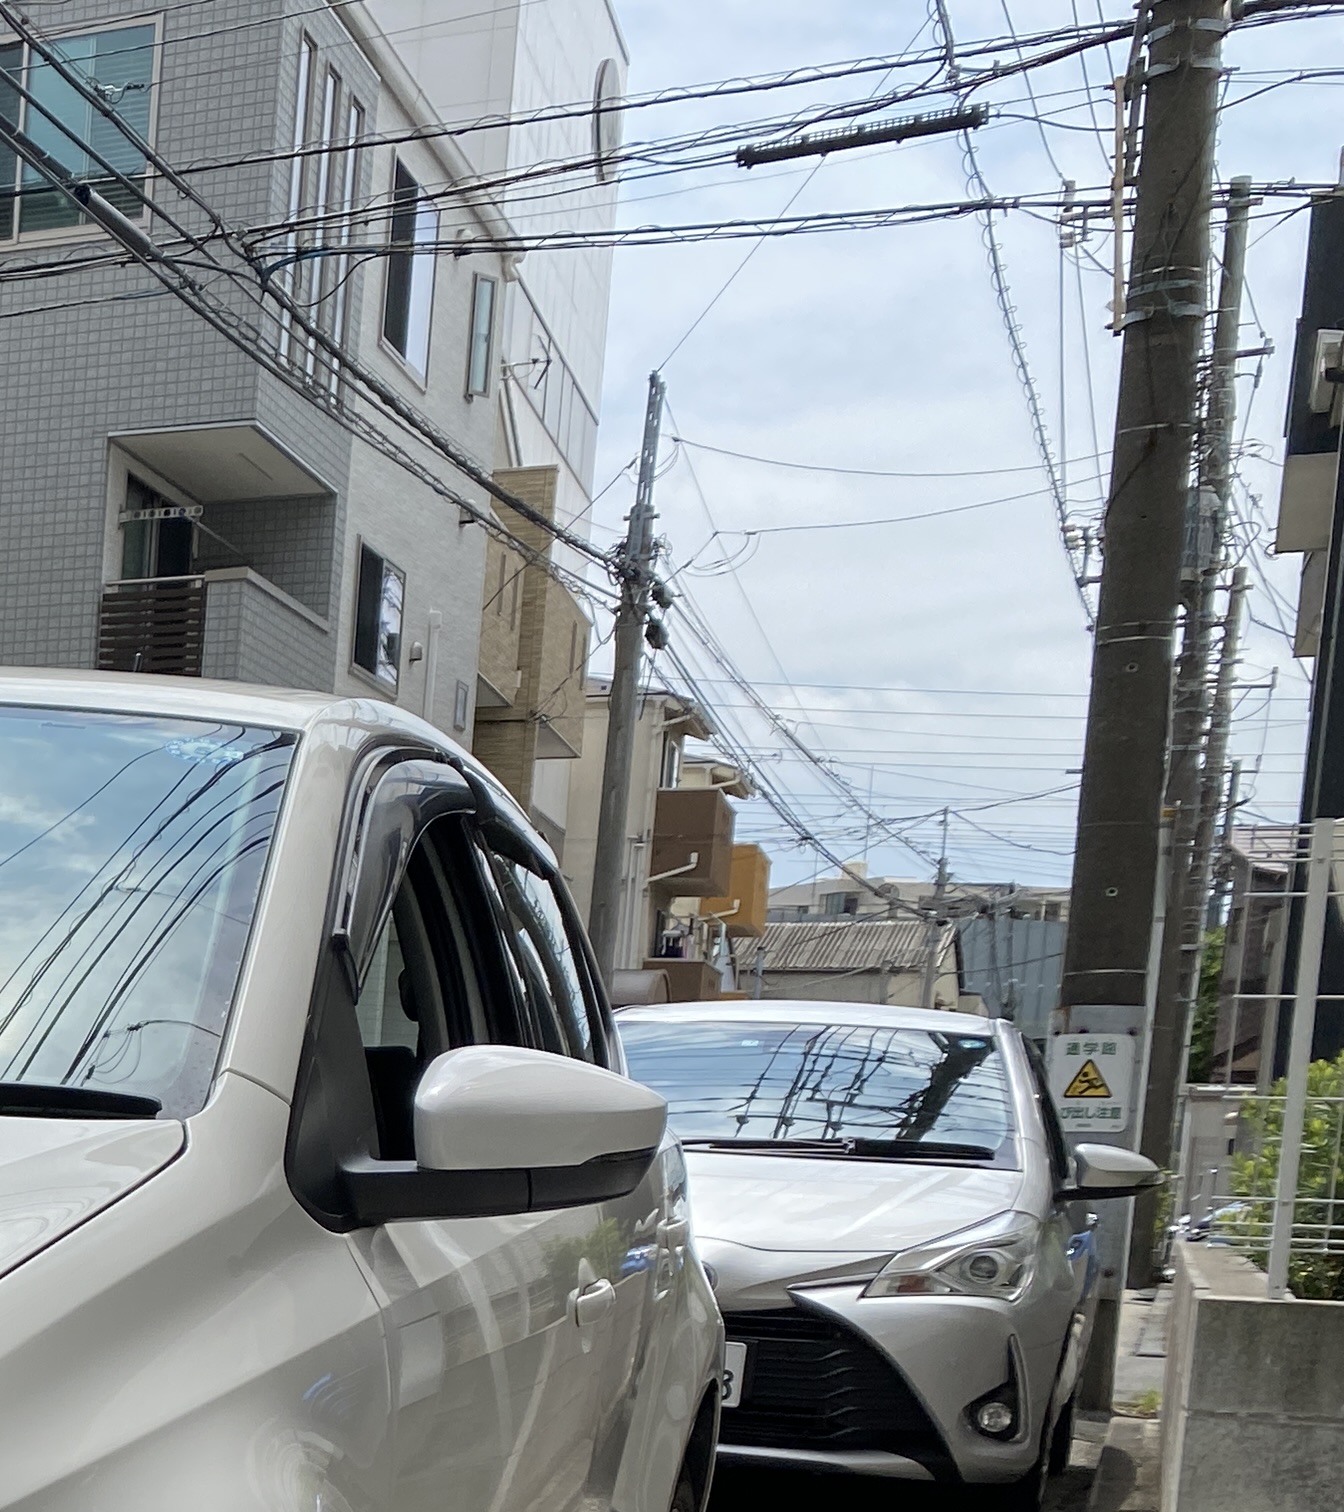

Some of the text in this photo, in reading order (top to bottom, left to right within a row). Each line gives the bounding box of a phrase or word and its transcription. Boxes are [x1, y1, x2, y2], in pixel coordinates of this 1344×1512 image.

[1060, 1106, 1122, 1119] び出し注意
